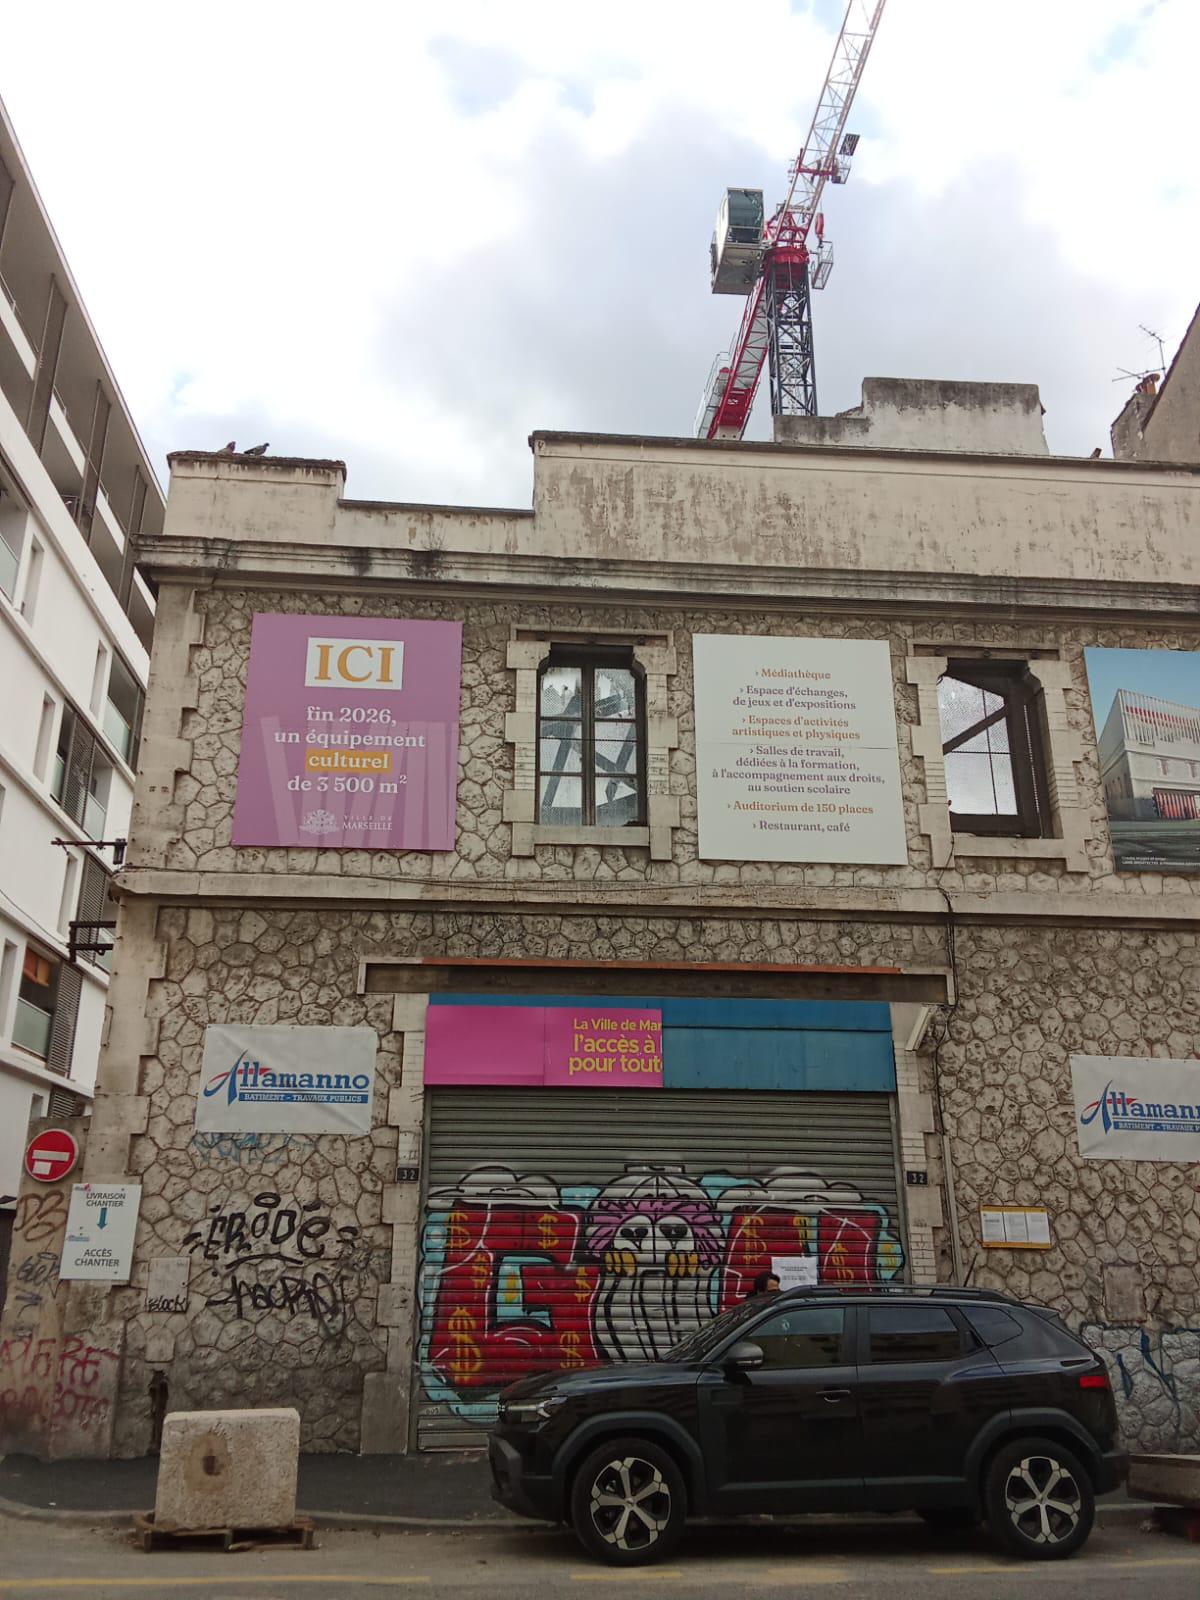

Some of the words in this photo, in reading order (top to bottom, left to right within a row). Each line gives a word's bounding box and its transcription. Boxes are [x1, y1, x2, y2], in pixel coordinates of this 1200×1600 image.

[314, 644, 395, 683] ICI
[761, 668, 831, 681] Médiathèque
[746, 686, 784, 698] Espace
[786, 686, 848, 699] d'échanges,
[733, 697, 746, 706] de
[747, 698, 771, 709] jeux
[773, 699, 783, 707] et
[785, 698, 856, 711] d'expositions
[306, 706, 334, 722] fin
[339, 707, 397, 726] 2026,
[749, 715, 792, 728] Espaces
[794, 716, 849, 727] d'activités
[274, 731, 300, 743] un
[305, 729, 426, 750] équipement
[732, 728, 790, 740] artistiques
[792, 729, 803, 738] et
[805, 729, 860, 742] physiques
[755, 746, 788, 756] Salles
[790, 746, 804, 756] de
[805, 747, 845, 759] travail,
[308, 752, 389, 769] culturel
[736, 757, 778, 768] dédiées
[779, 757, 786, 768] à
[788, 758, 799, 768] la
[800, 758, 860, 771] formation,
[287, 775, 312, 791] de
[712, 768, 719, 778] à
[720, 768, 824, 783] l'accompagnement
[826, 773, 847, 782] aux
[848, 772, 885, 785] droits,
[747, 784, 762, 793] au
[763, 783, 805, 794] soutien
[806, 783, 851, 795] scolaire
[733, 800, 799, 812] Auditorium
[800, 802, 814, 813] de
[816, 803, 836, 813] 150
[838, 803, 874, 816] places
[342, 821, 393, 831] MARSEILLE
[759, 820, 825, 833] Restaurant,
[826, 821, 850, 832] café
[573, 1018, 588, 1030] La
[591, 1018, 618, 1030] Ville
[620, 1018, 637, 1031] de
[574, 1033, 640, 1054] l'accès
[643, 1034, 656, 1054] à
[569, 1057, 616, 1076] pour
[620, 1054, 662, 1073] tout
[203, 1049, 370, 1107] Allamanno
[292, 1094, 329, 1102] TRAVAUX
[329, 1094, 362, 1103] PUBLICS
[1081, 1079, 1200, 1135] Allaman
[1162, 1124, 1194, 1132] TRAVAUX
[401, 1169, 416, 1180] 32
[911, 1173, 924, 1184] 32
[86, 1192, 126, 1200] LIVRAISON
[86, 1200, 124, 1208] CHANTIER
[83, 1248, 113, 1258] ACCÈS
[74, 1258, 120, 1267] CHANTIER
